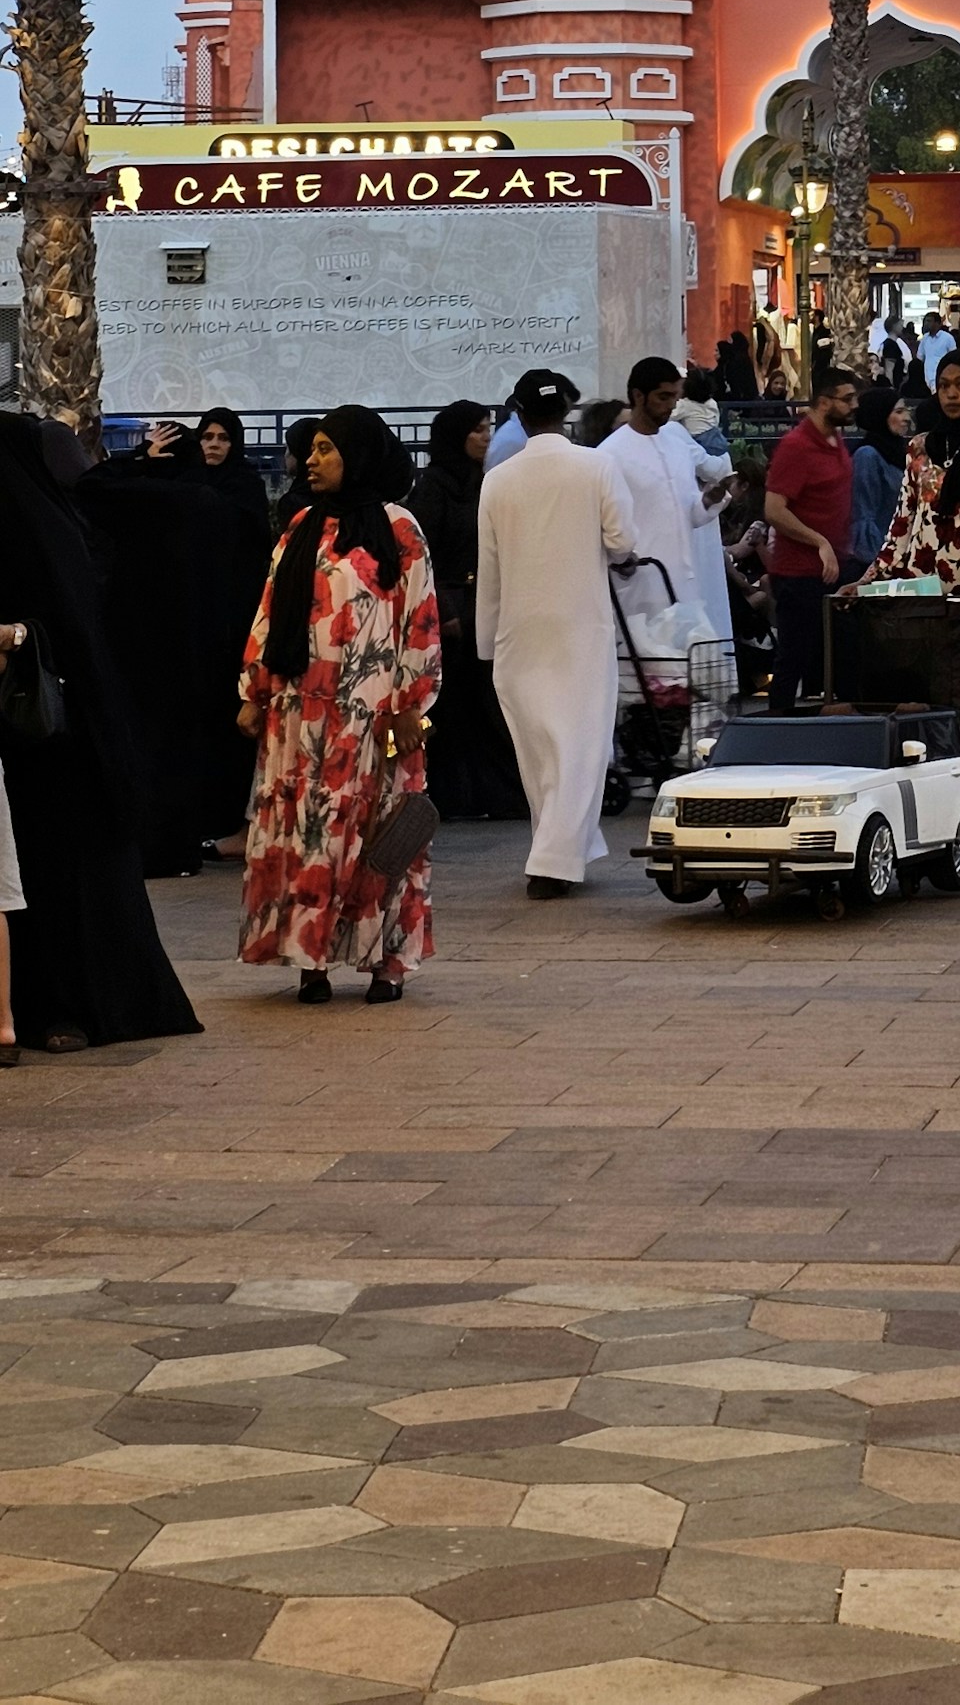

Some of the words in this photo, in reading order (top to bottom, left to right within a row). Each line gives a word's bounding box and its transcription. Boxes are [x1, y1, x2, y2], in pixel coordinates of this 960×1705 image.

[175, 172, 322, 206] CAFE
[356, 167, 624, 204] MOZART
[315, 252, 370, 271] VIENNA
[99, 299, 133, 312] EST
[137, 298, 202, 311] COFFEE
[207, 299, 226, 310] IN
[232, 297, 303, 310] EUROPE
[307, 297, 325, 309] IS
[331, 295, 398, 309] VIENNA
[402, 294, 474, 309] COFFEE,
[142, 322, 166, 334] TO
[171, 321, 232, 334] WHICH
[234, 320, 272, 333] ALL
[276, 319, 339, 333] OTHER
[343, 318, 409, 332] COFFEE
[413, 318, 431, 331] IS
[436, 317, 488, 331] FLUID
[520, 341, 582, 354] TWAIN
